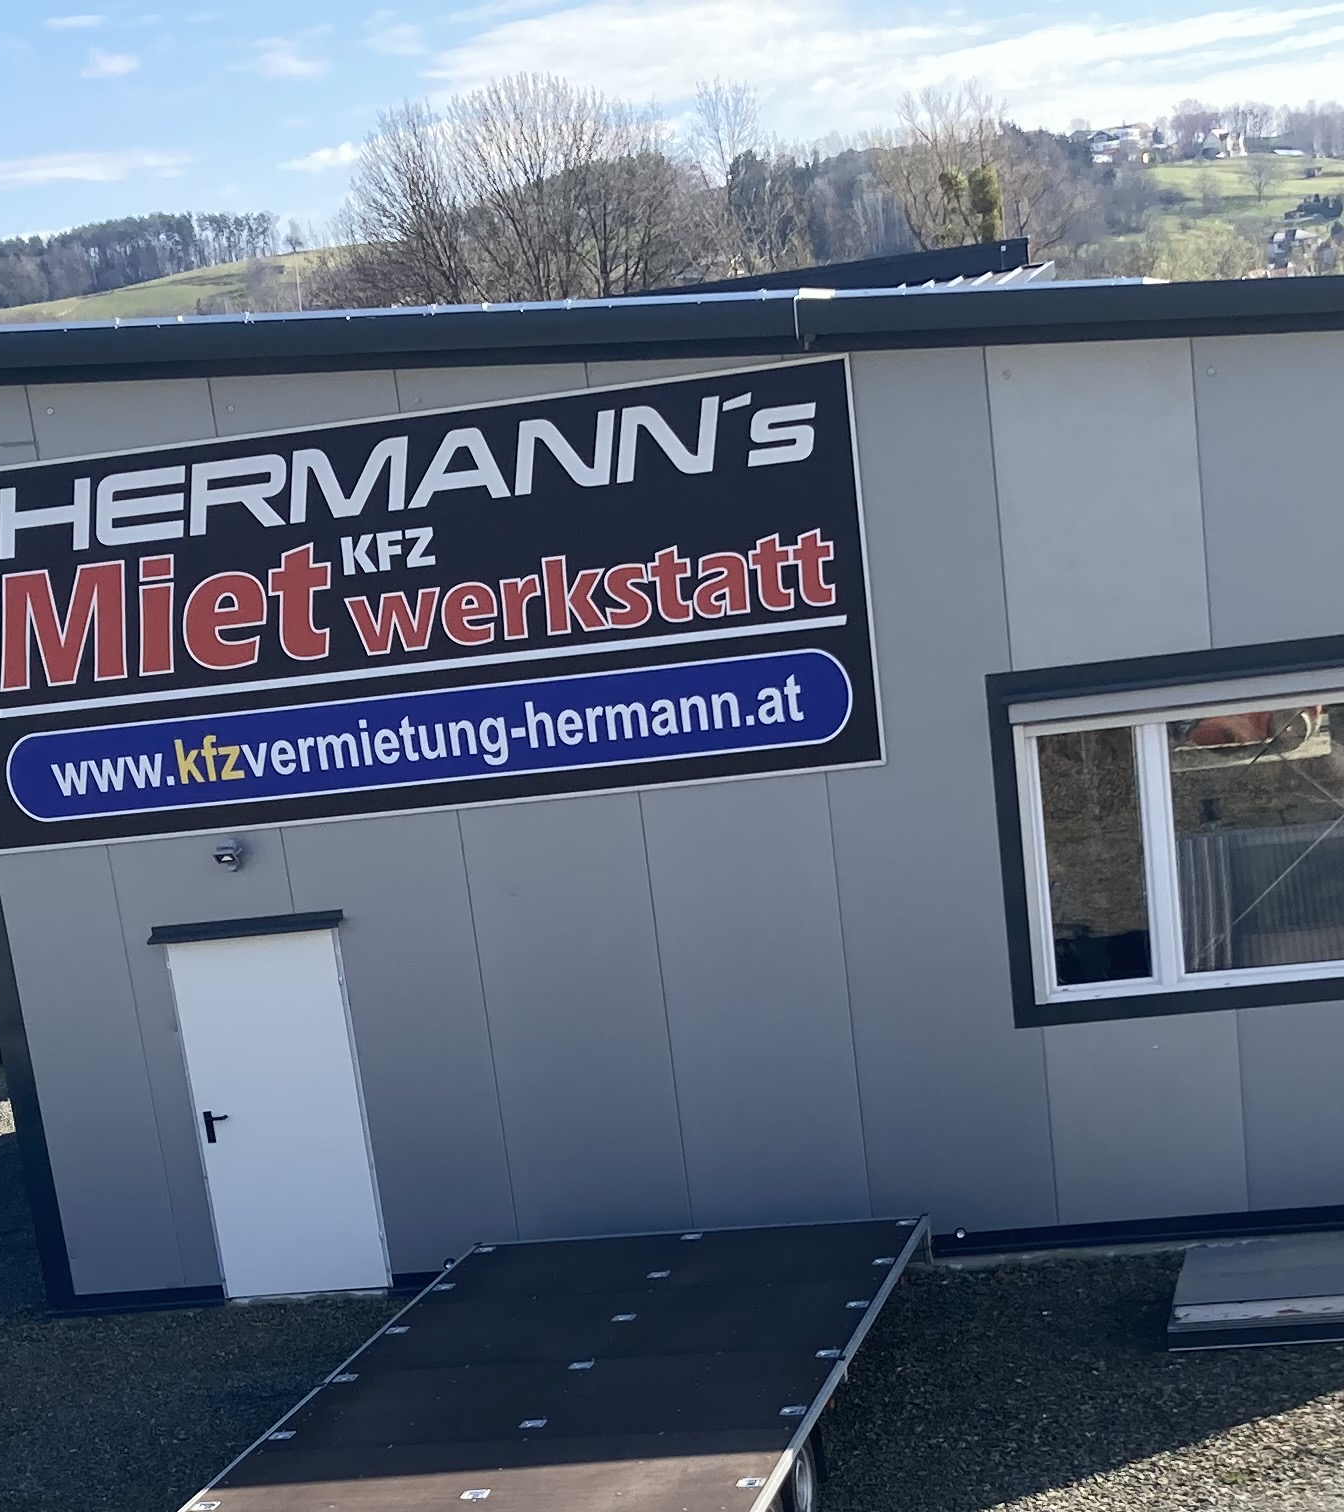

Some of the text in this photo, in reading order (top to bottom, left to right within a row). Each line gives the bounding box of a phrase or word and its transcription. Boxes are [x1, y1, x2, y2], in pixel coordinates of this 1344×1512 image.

[0, 528, 837, 694] Miet werkstatt
[340, 526, 437, 577] KFZ
[52, 673, 805, 799] www.kfzvermietung-hermann.at
